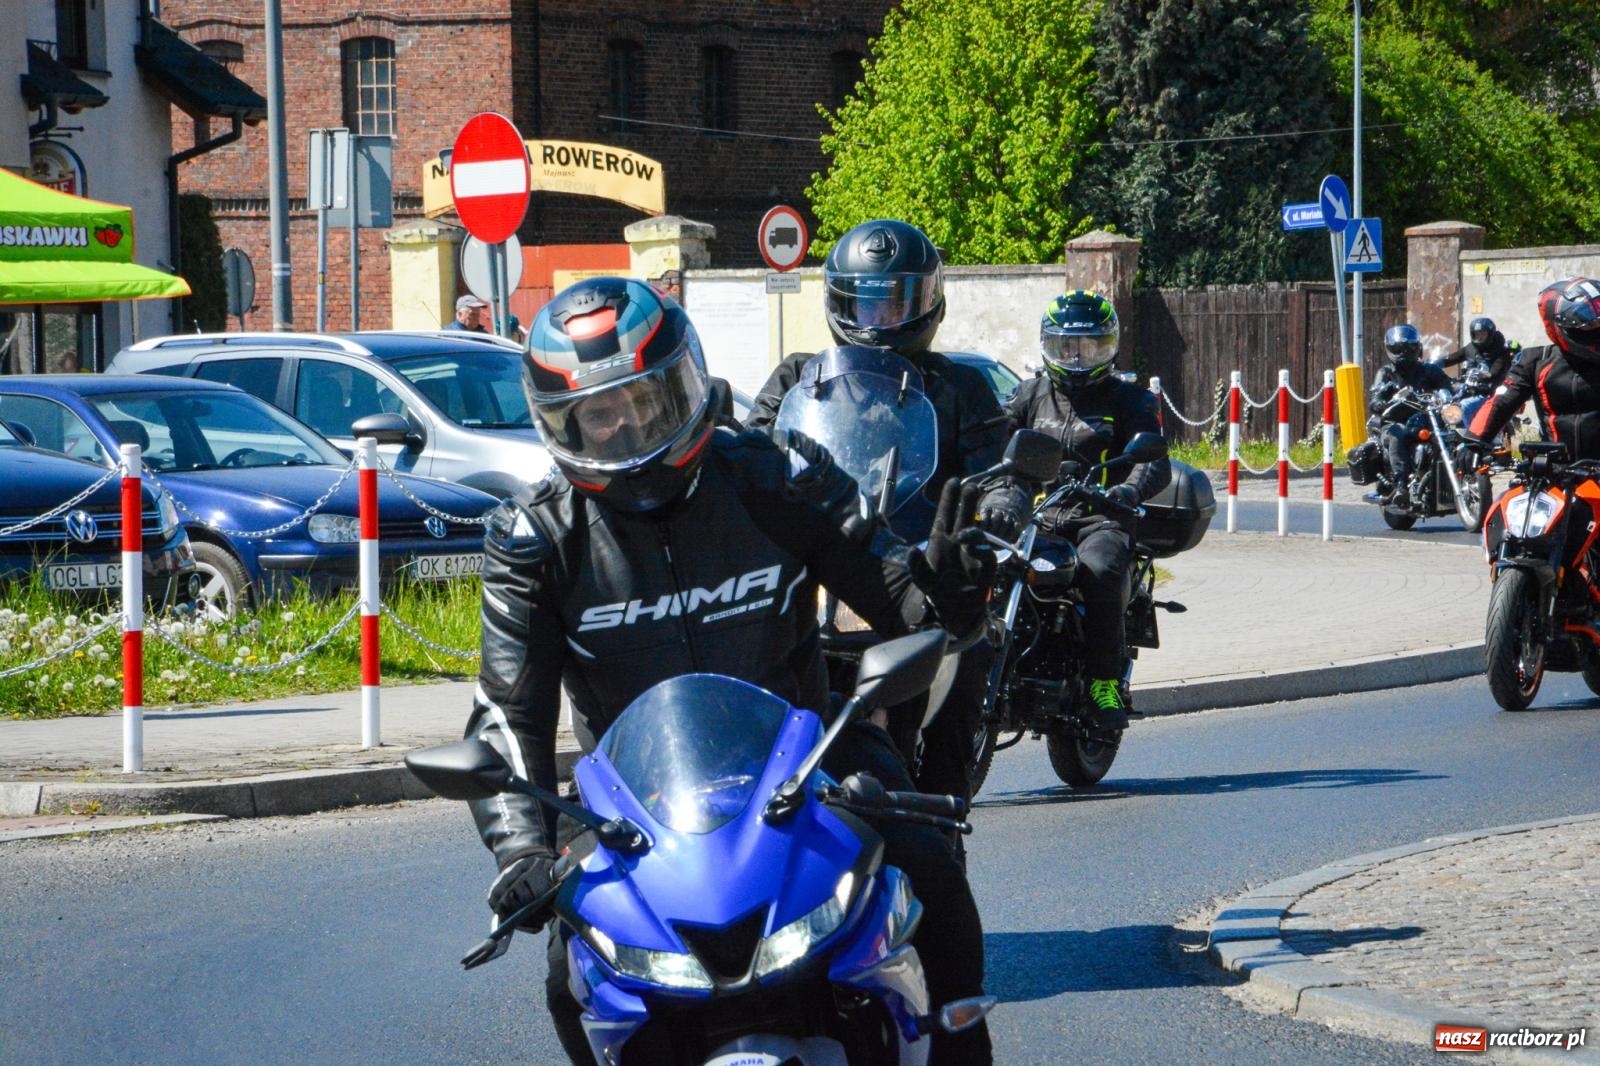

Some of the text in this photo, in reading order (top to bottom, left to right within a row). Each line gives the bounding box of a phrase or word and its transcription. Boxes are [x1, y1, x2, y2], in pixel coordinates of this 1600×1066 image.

[542, 144, 655, 182] ROWERÓW
[0, 225, 89, 247] SKAWKI
[571, 352, 637, 381] LS2
[420, 555, 484, 576] OK 81202
[54, 566, 89, 588] OGL
[577, 564, 783, 632] SHIMA
[726, 1058, 765, 1066] MAHA
